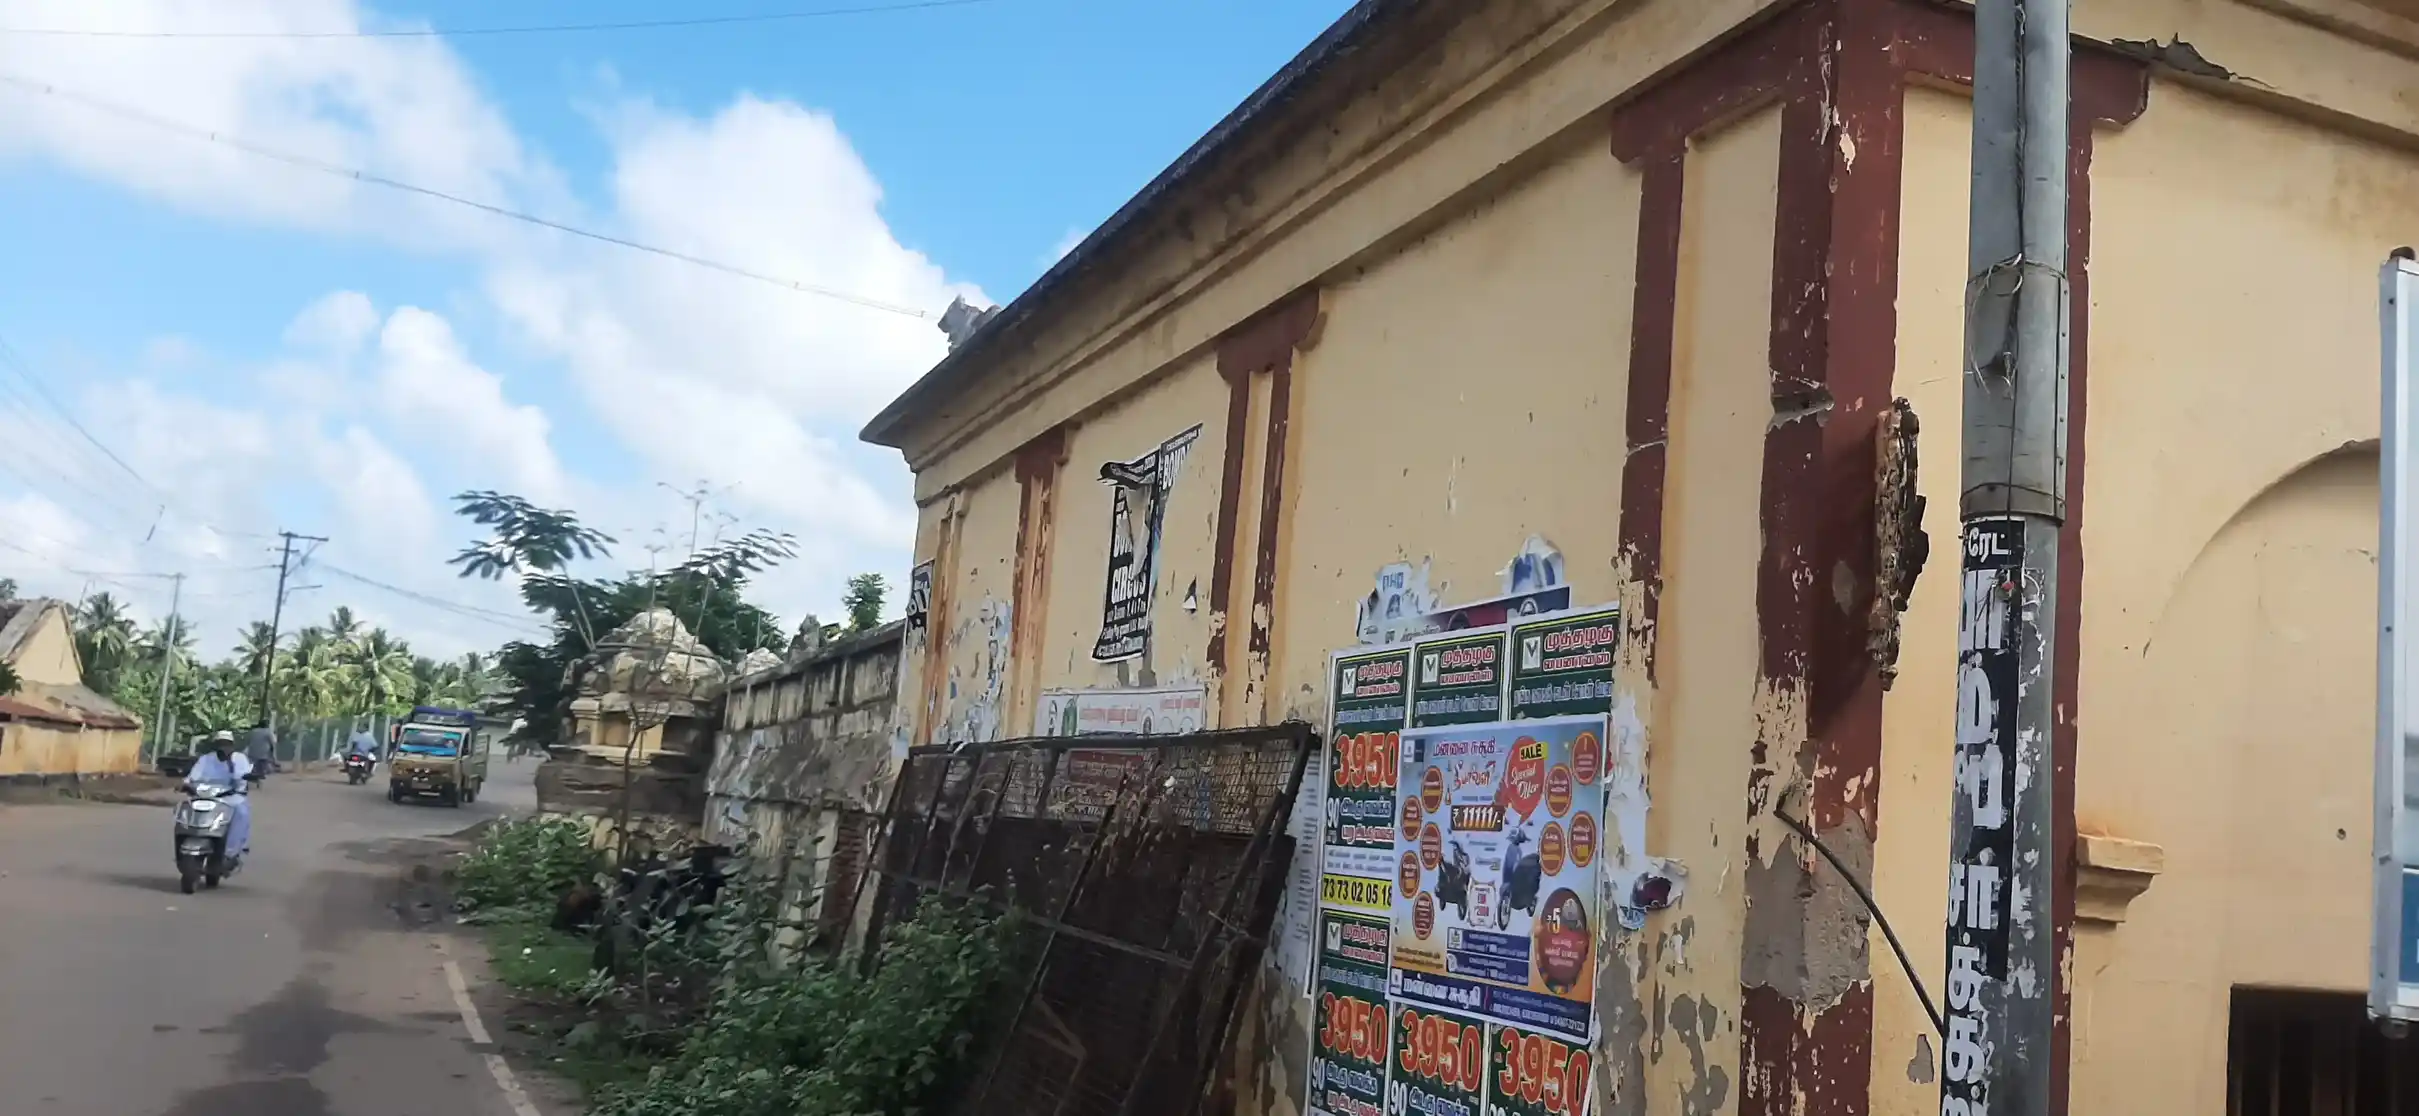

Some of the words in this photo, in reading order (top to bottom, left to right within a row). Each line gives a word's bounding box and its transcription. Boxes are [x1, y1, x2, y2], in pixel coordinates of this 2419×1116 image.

[1544, 624, 1614, 652] முத்தழகு
[1334, 731, 1399, 788] 3950
[1520, 743, 1543, 760] SALE
[1511, 762, 1537, 785] Special
[1327, 798, 1340, 829] 90
[1323, 878, 1335, 898] 73
[1337, 879, 1349, 900] 73
[1351, 881, 1363, 902] 02
[1366, 882, 1378, 905] 05
[1319, 991, 1388, 1066] 3950
[1400, 1009, 1482, 1092] 3950
[1312, 1056, 1325, 1091] 90
[1498, 1027, 1590, 1116] 3950
[1391, 1080, 1408, 1116] 90
